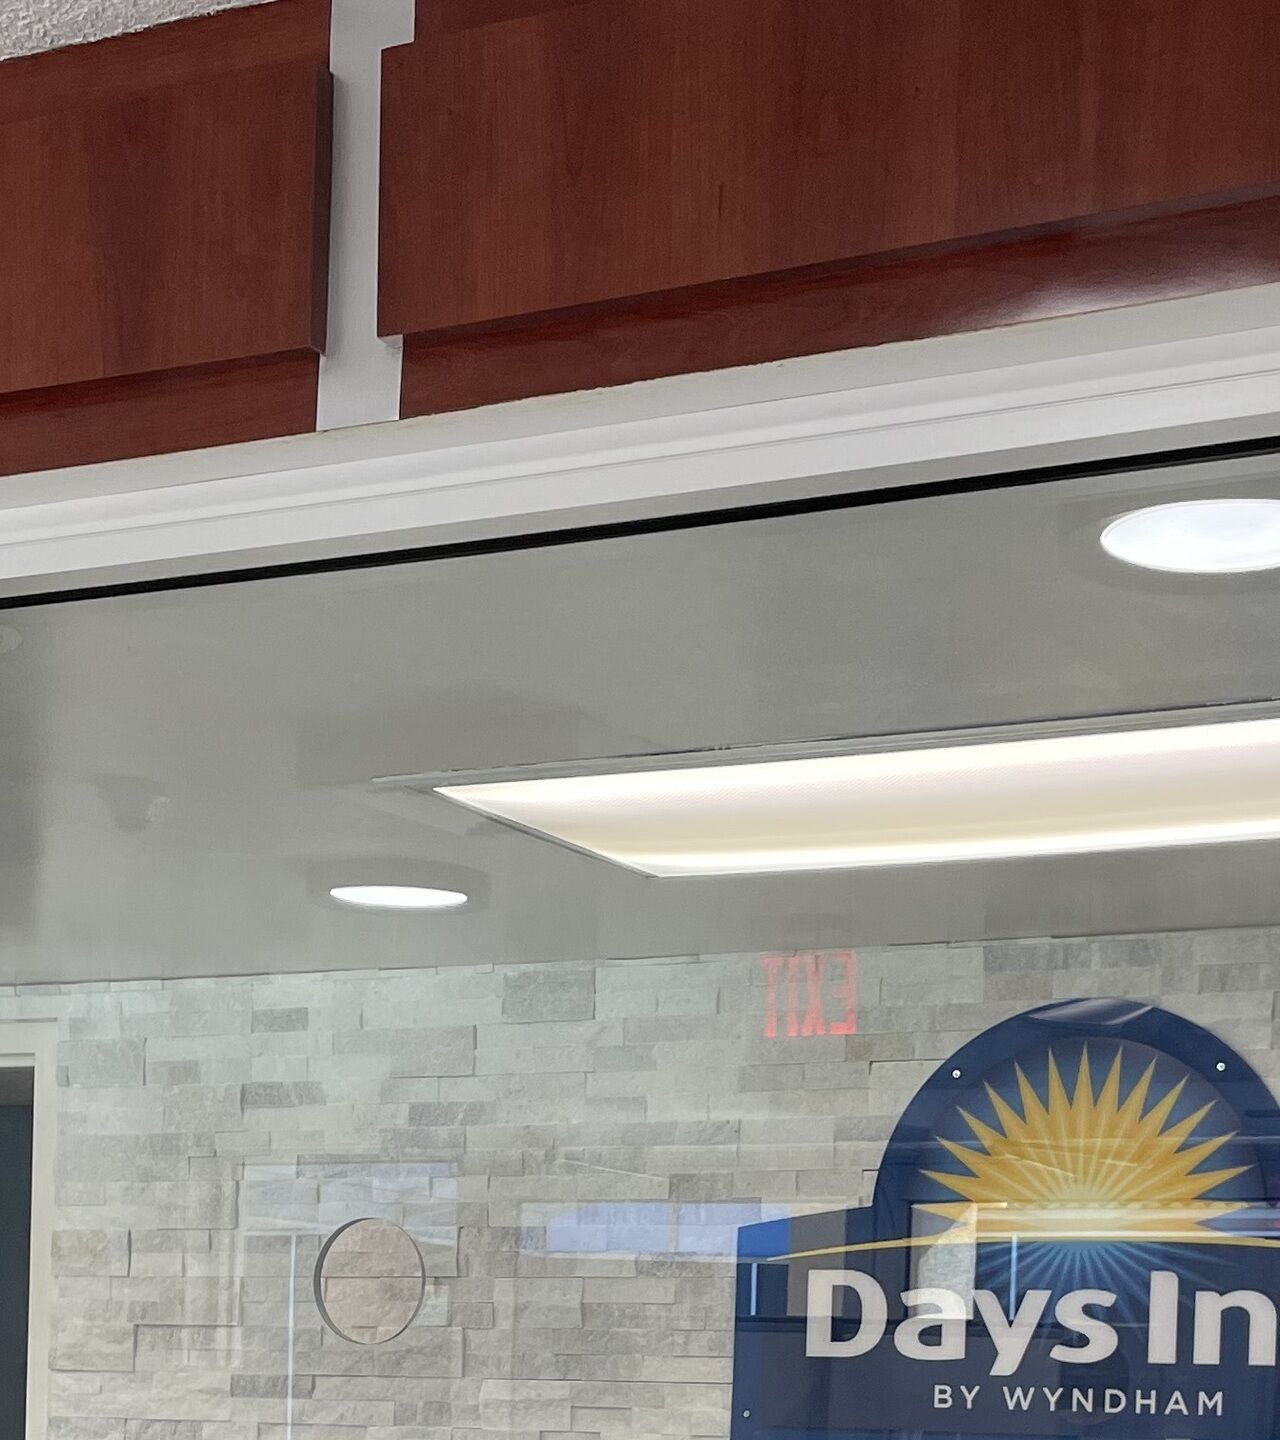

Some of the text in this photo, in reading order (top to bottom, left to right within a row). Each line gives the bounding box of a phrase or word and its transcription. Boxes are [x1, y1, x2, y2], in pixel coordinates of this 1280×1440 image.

[805, 1269, 1119, 1376] Days
[933, 1384, 1223, 1416] BY WYNDHAM
